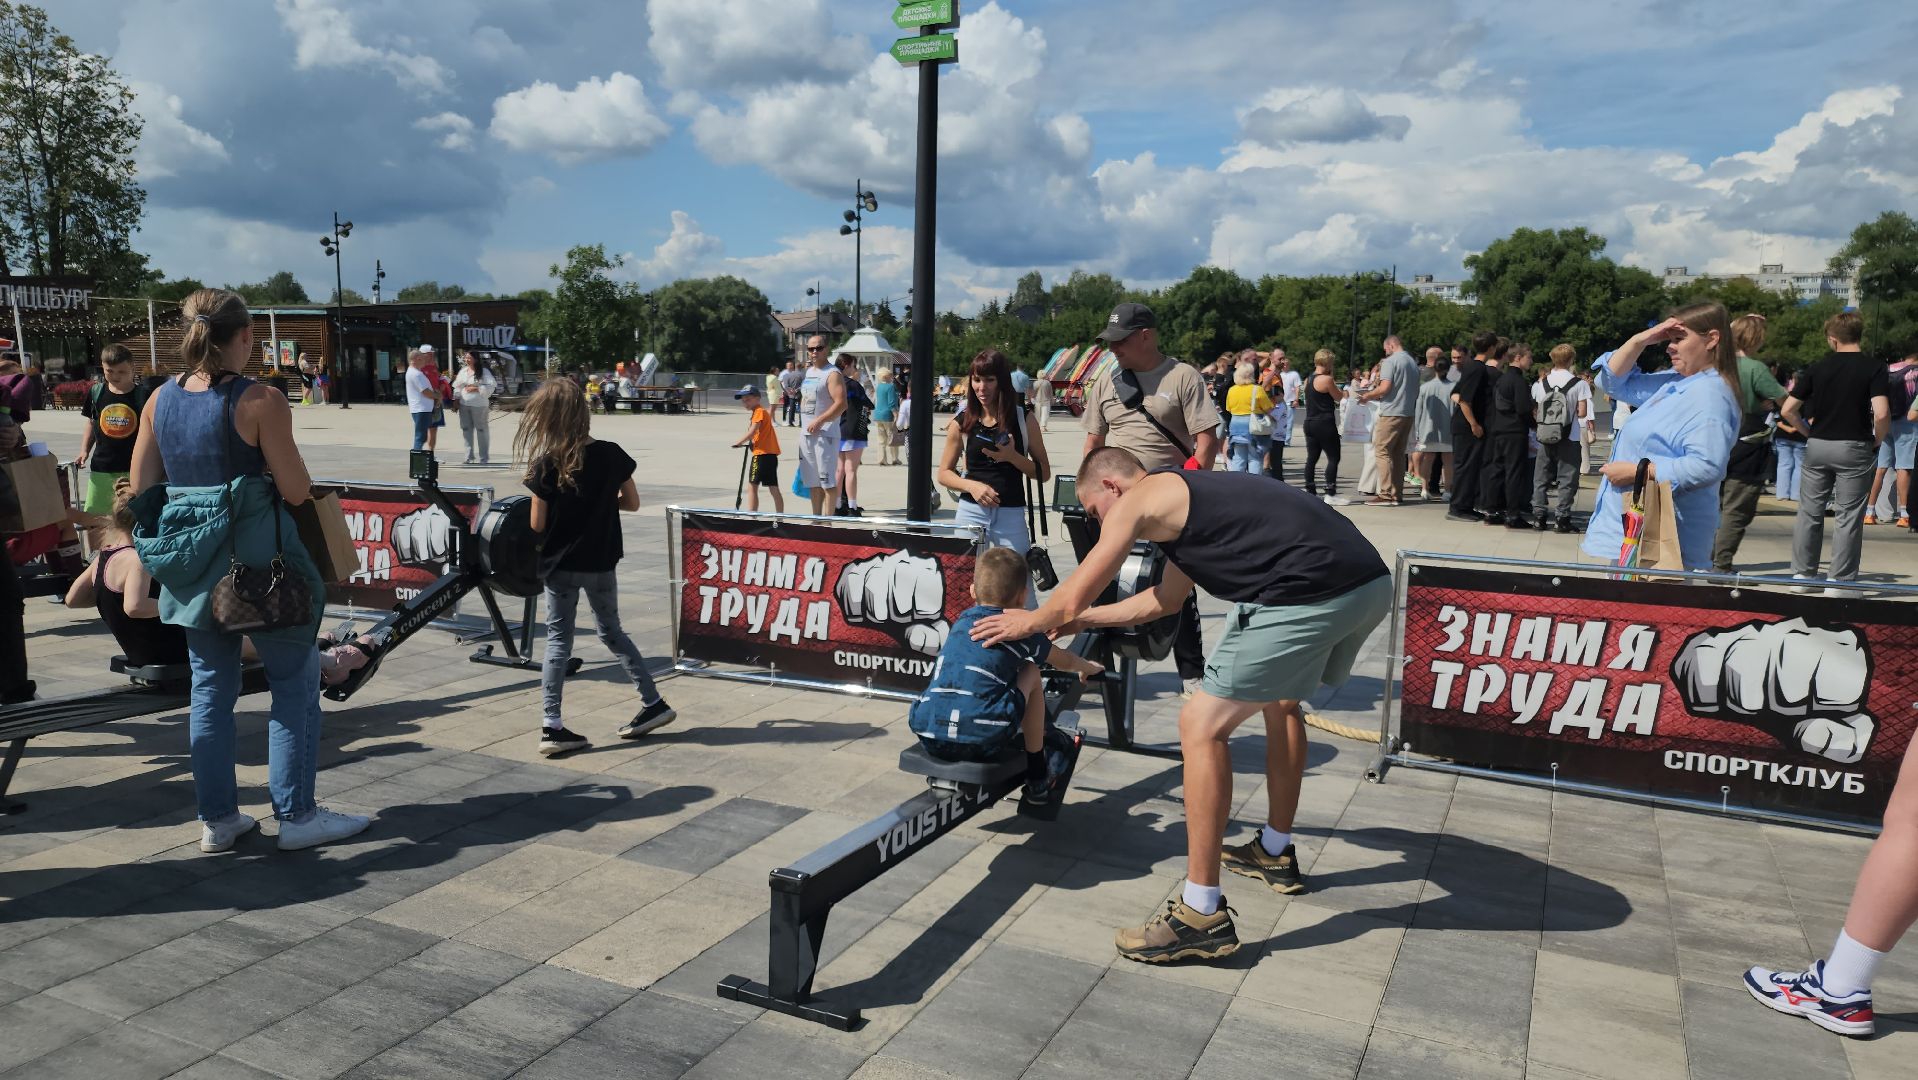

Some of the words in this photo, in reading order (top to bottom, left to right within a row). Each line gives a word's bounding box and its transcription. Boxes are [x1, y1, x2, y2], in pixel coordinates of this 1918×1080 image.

[463, 327, 493, 347] ГОРОД
[700, 543, 825, 592] ЗНАМЯ
[700, 586, 829, 645] ТРУДА
[1435, 606, 1657, 671] ЗНАМЯ
[834, 650, 935, 678] СПОРТКЛУ
[1430, 660, 1662, 740] ТРУДА
[1664, 750, 1865, 795] СПОРТКЛУБ
[876, 784, 989, 863] YOUSTEL
